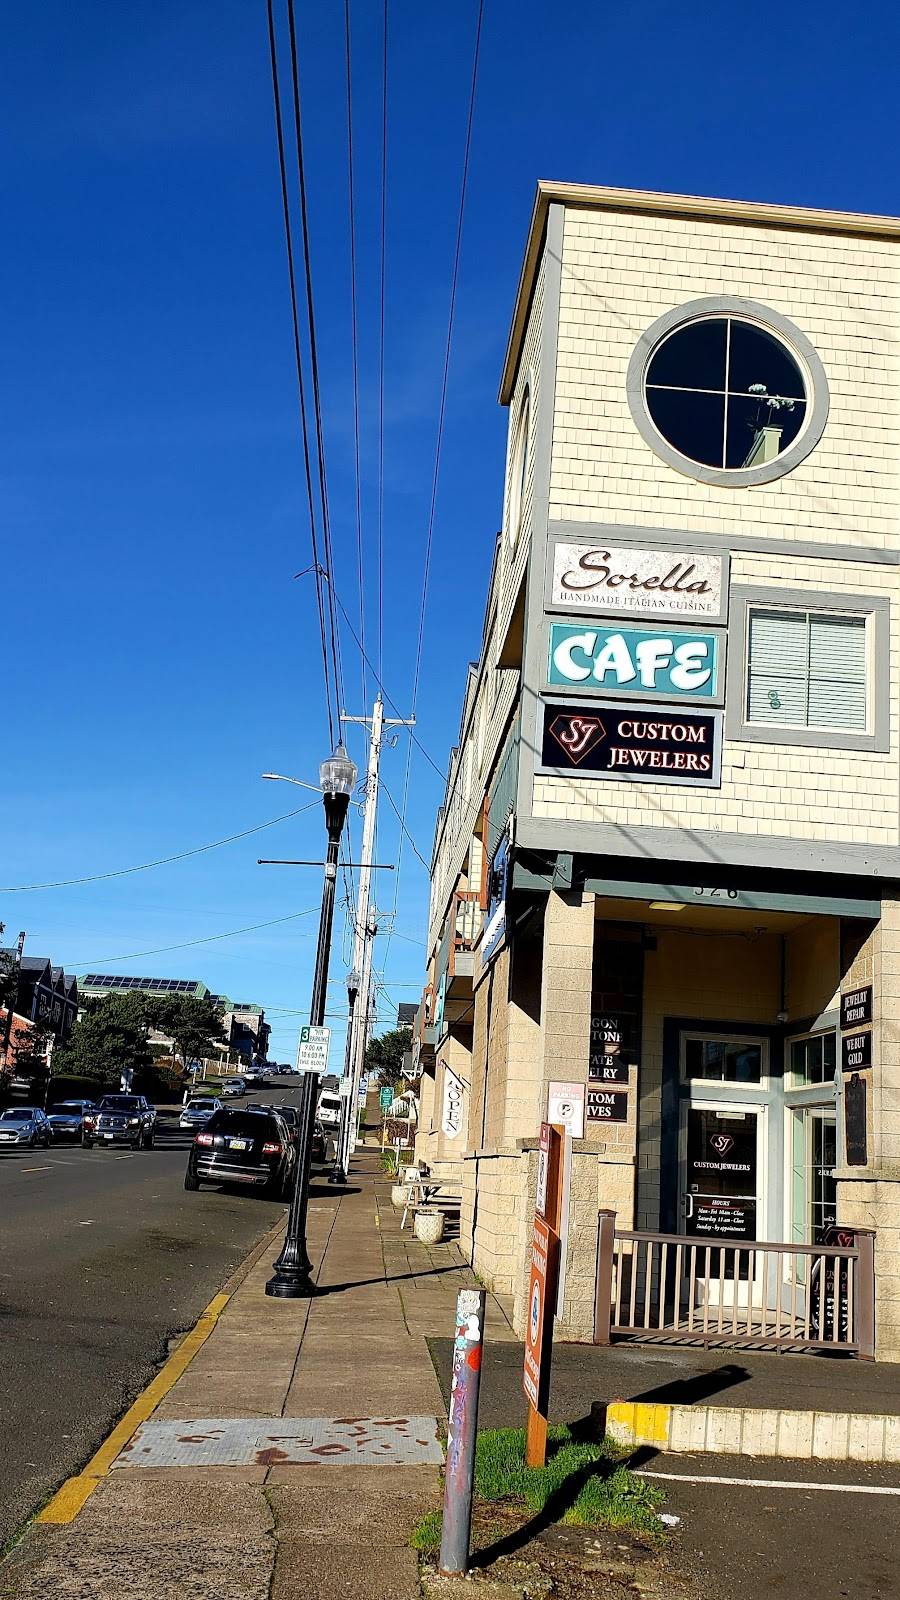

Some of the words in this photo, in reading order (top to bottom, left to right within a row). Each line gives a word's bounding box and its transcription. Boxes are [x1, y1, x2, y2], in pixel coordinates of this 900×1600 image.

[561, 550, 713, 595] Sorella
[560, 592, 620, 606] HANDMADE
[623, 597, 666, 610] ITALIAN
[669, 600, 713, 613] CUISINE
[553, 632, 711, 690] CAFE
[617, 721, 706, 744] CUSTOM
[607, 747, 711, 771] JEWELERS
[844, 990, 868, 1012] JEWELRY
[846, 1006, 865, 1022] REPAIR
[302, 1029, 309, 1041] 3
[846, 1038, 855, 1052] WE
[848, 1051, 863, 1066] GOLD
[446, 1089, 461, 1132] OPEN
[693, 1161, 720, 1169] CUSTOM
[720, 1162, 751, 1171] JEWELERS
